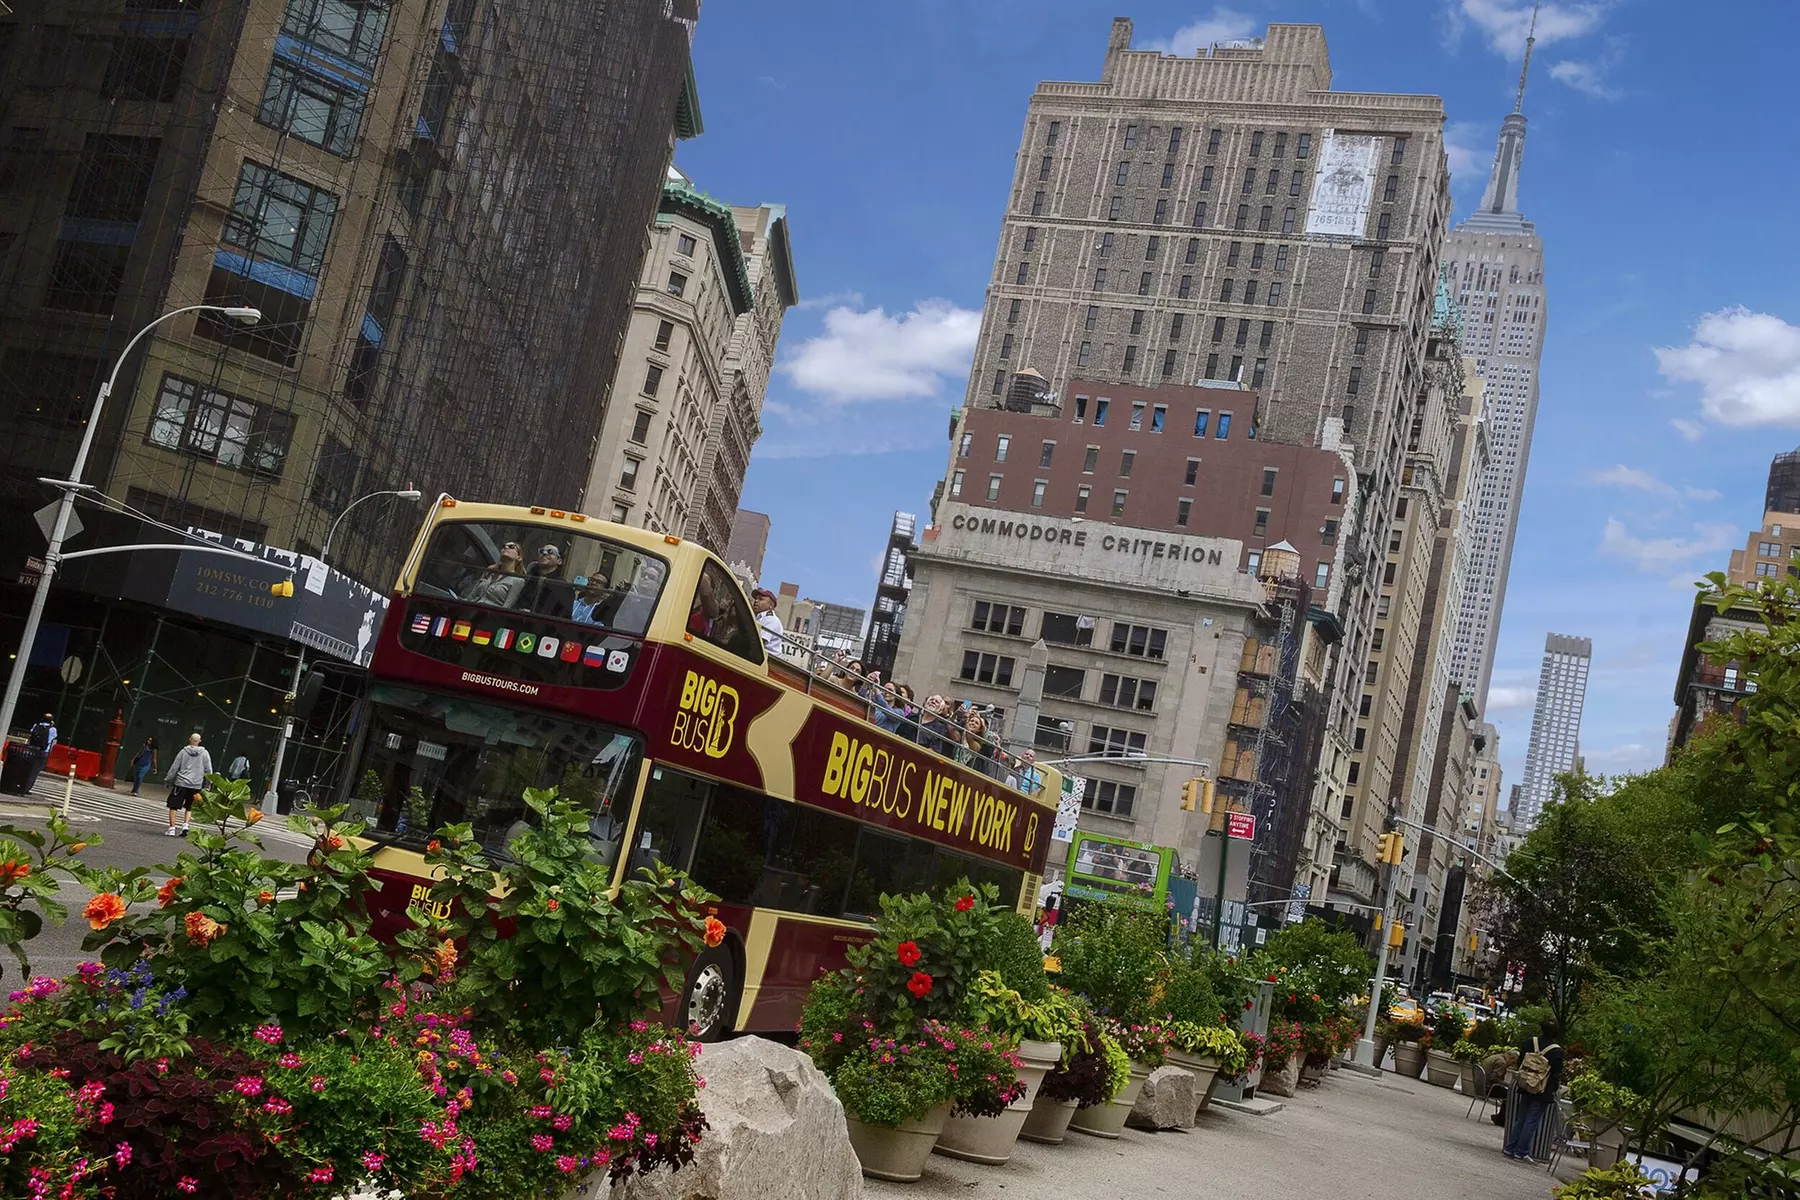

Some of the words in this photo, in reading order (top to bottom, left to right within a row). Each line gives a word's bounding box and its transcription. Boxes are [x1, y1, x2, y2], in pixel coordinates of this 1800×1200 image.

[953, 514, 1088, 547] COMMODORE
[1103, 535, 1223, 567] CRITERION
[196, 582, 218, 596] 212
[222, 588, 243, 601] 776
[248, 595, 274, 609] 1110
[197, 566, 270, 592] 10MSW.CO
[461, 671, 539, 696] BIGBUSTOURS.COM
[680, 670, 717, 716] BIG
[670, 711, 708, 752] BUS
[917, 769, 971, 836] NEW
[970, 790, 1017, 853] YORK
[1140, 843, 1153, 851] 307
